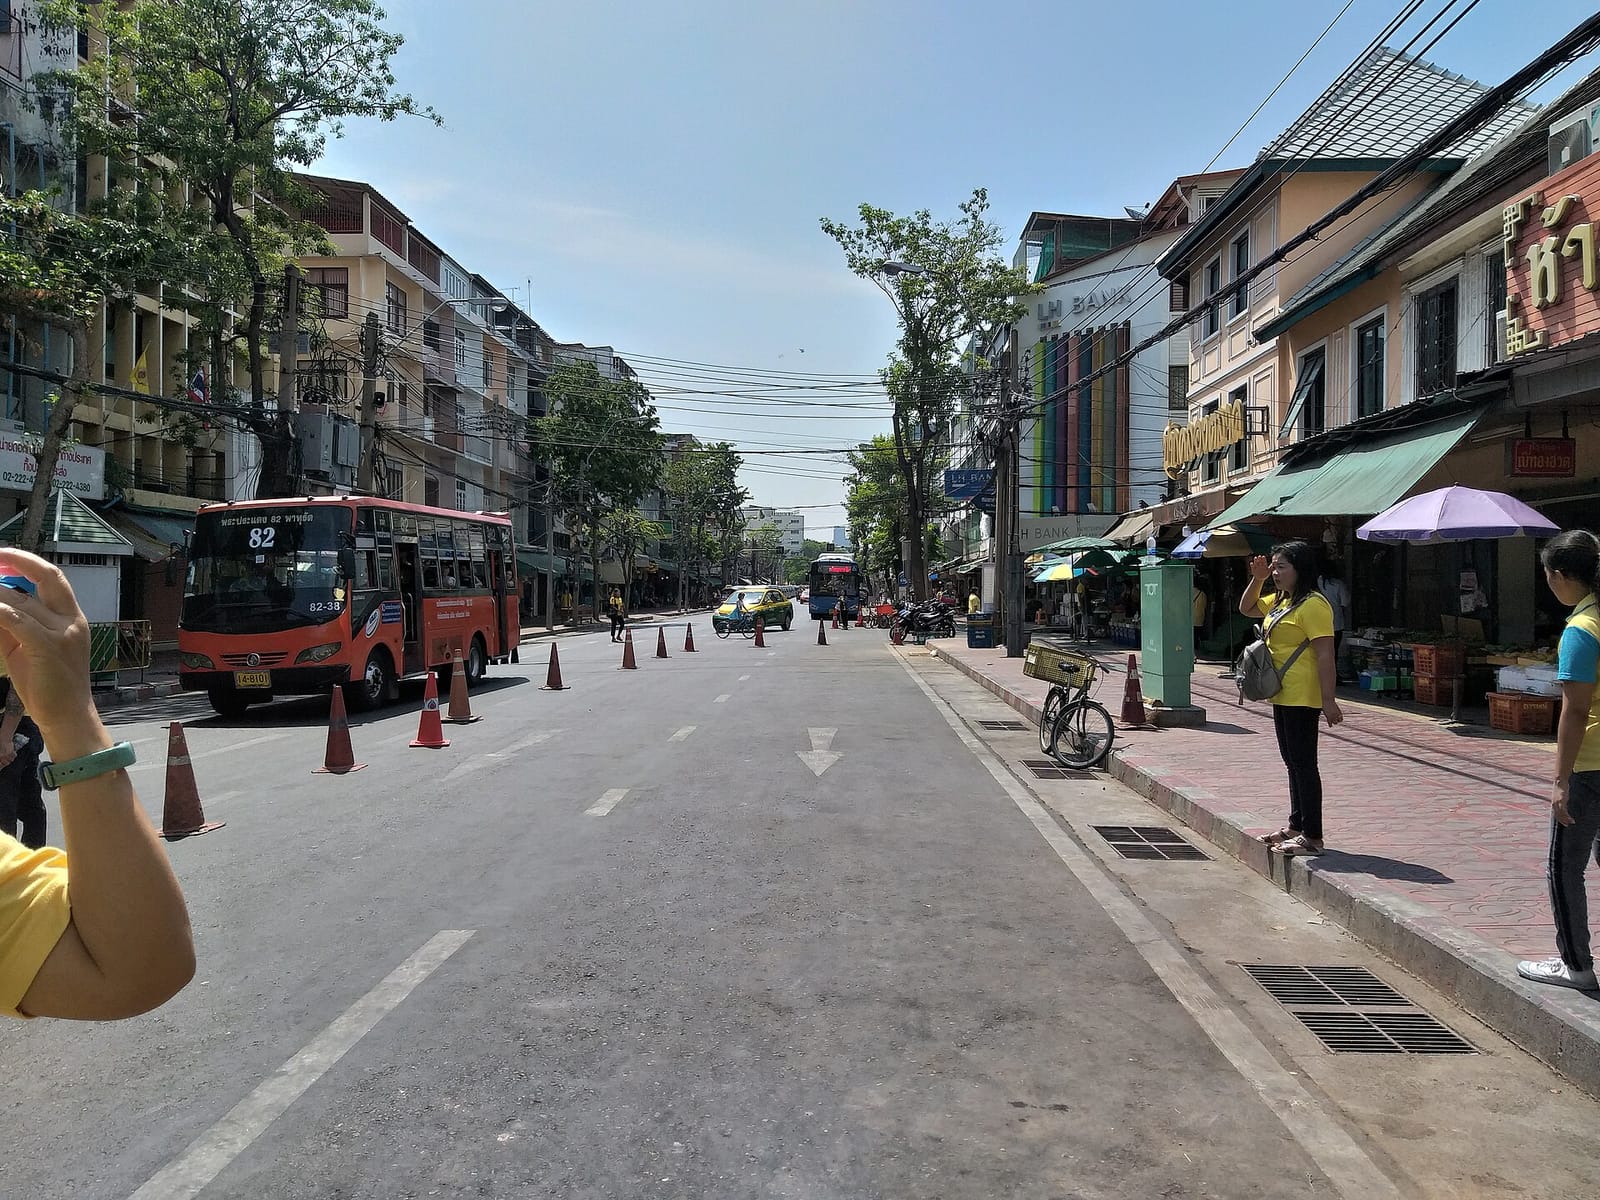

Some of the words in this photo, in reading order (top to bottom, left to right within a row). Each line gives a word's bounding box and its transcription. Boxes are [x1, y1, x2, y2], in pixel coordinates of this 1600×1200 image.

[1037, 300, 1062, 320] LH
[1072, 284, 1132, 315] BANK
[970, 473, 992, 481] BAN
[270, 515, 281, 523] 82
[249, 527, 276, 548] 82
[1034, 527, 1070, 539] BANK
[309, 602, 341, 612] 82-38
[237, 674, 269, 684] 14-8101
